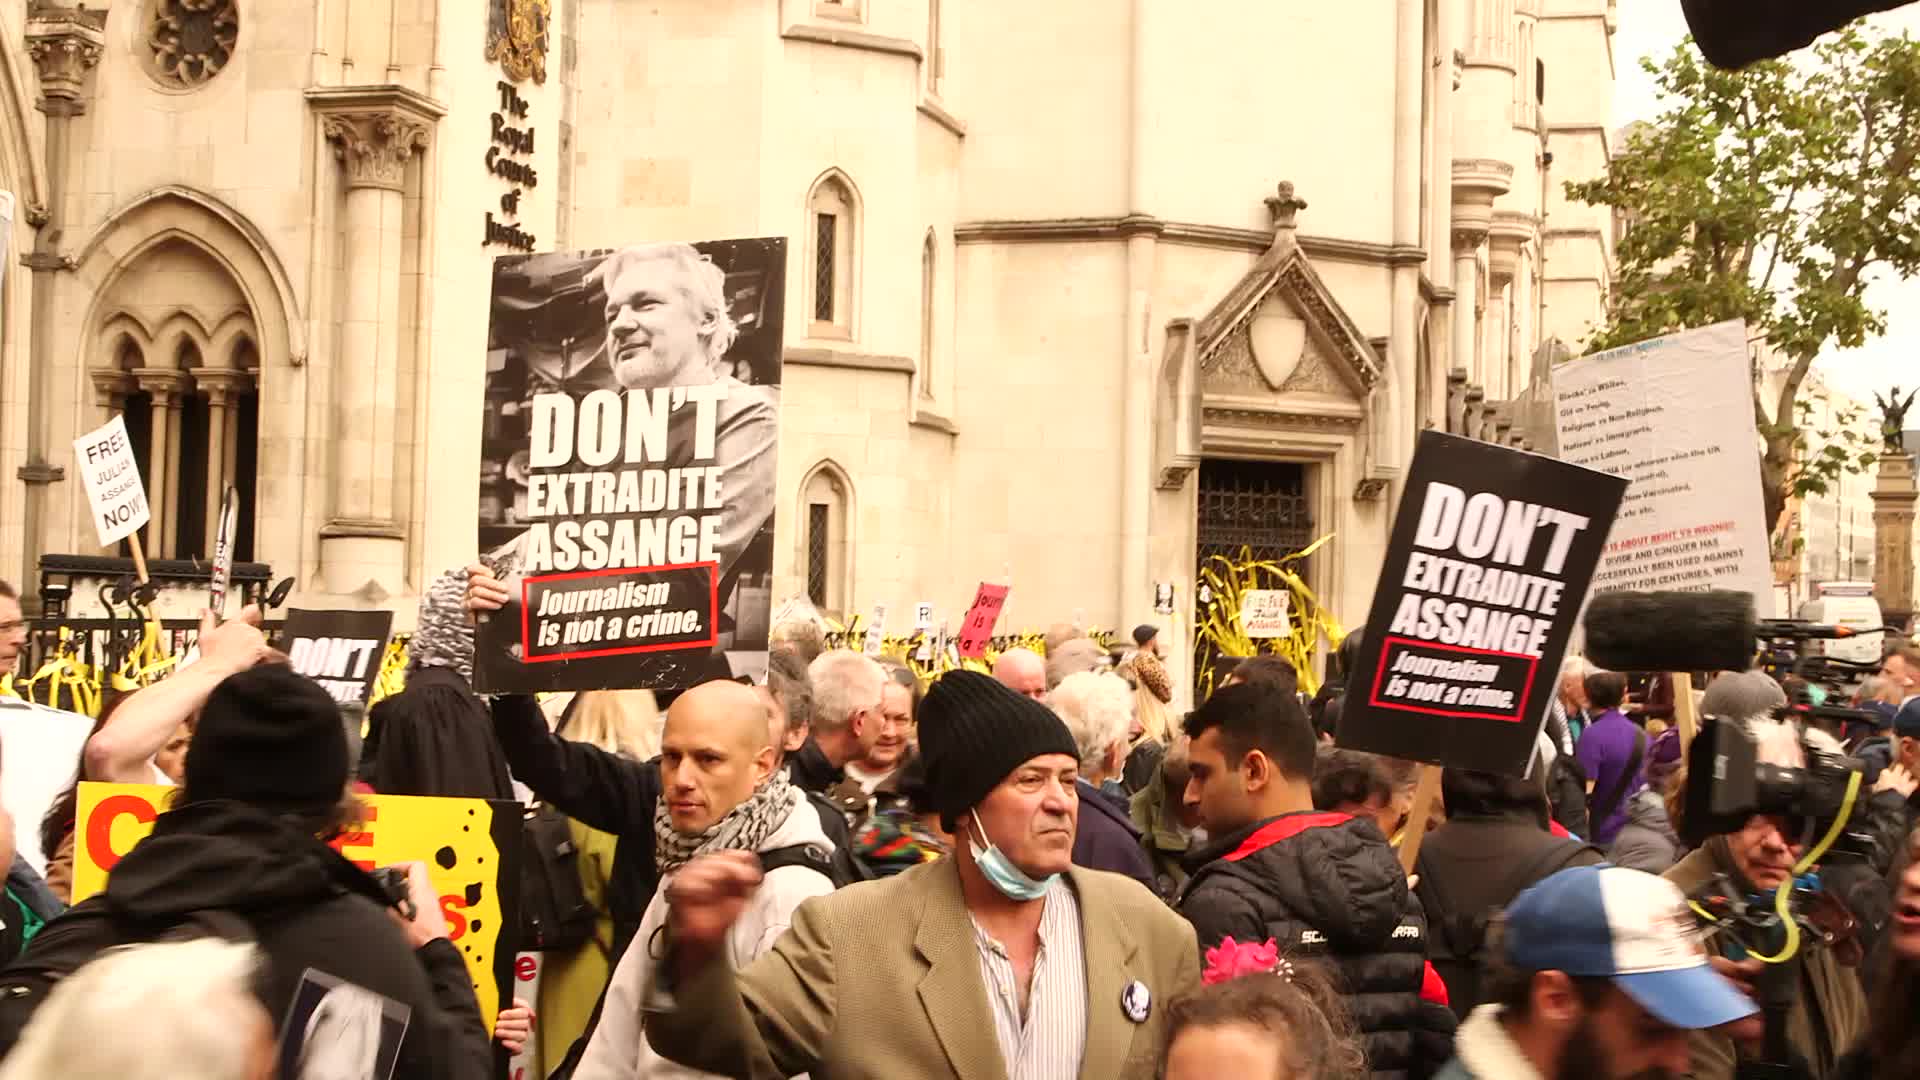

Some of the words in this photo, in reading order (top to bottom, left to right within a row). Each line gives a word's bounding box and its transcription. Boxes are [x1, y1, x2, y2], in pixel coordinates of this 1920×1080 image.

[497, 80, 529, 120] The
[491, 112, 535, 156] Royal
[485, 146, 537, 188] Courts
[501, 188, 521, 215] of
[482, 211, 536, 252] Justice
[530, 384, 728, 468] DON'T
[86, 430, 126, 464] FREE
[528, 466, 724, 517] EXTRADITE
[526, 515, 722, 572] ASSANGE
[1414, 481, 1591, 575] DON'T
[1620, 535, 1649, 552] ABOUT
[1651, 530, 1677, 545] RIGHT
[1605, 553, 1632, 567] DIVIDE
[1634, 549, 1653, 561] AND
[1654, 541, 1697, 556] CONQUER
[1699, 537, 1719, 549] HAS
[1651, 560, 1674, 572] BEEN
[1676, 554, 1702, 568] USED
[1703, 548, 1744, 564] AGAINST
[1403, 551, 1566, 616] EXTRADITE
[1639, 577, 1657, 589] FOR
[1714, 563, 1739, 577] WITH
[537, 581, 670, 617] Journalism
[537, 620, 560, 647] is
[563, 616, 602, 645] not
[606, 617, 623, 640] a
[625, 608, 703, 638] crime.
[1389, 593, 1552, 659] ASSANGE
[289, 637, 378, 678] DON'T
[1391, 650, 1500, 683] Journalism
[1384, 675, 1409, 698] is
[1407, 680, 1443, 703] not
[1444, 687, 1460, 704] a
[1458, 685, 1514, 709] crime.
